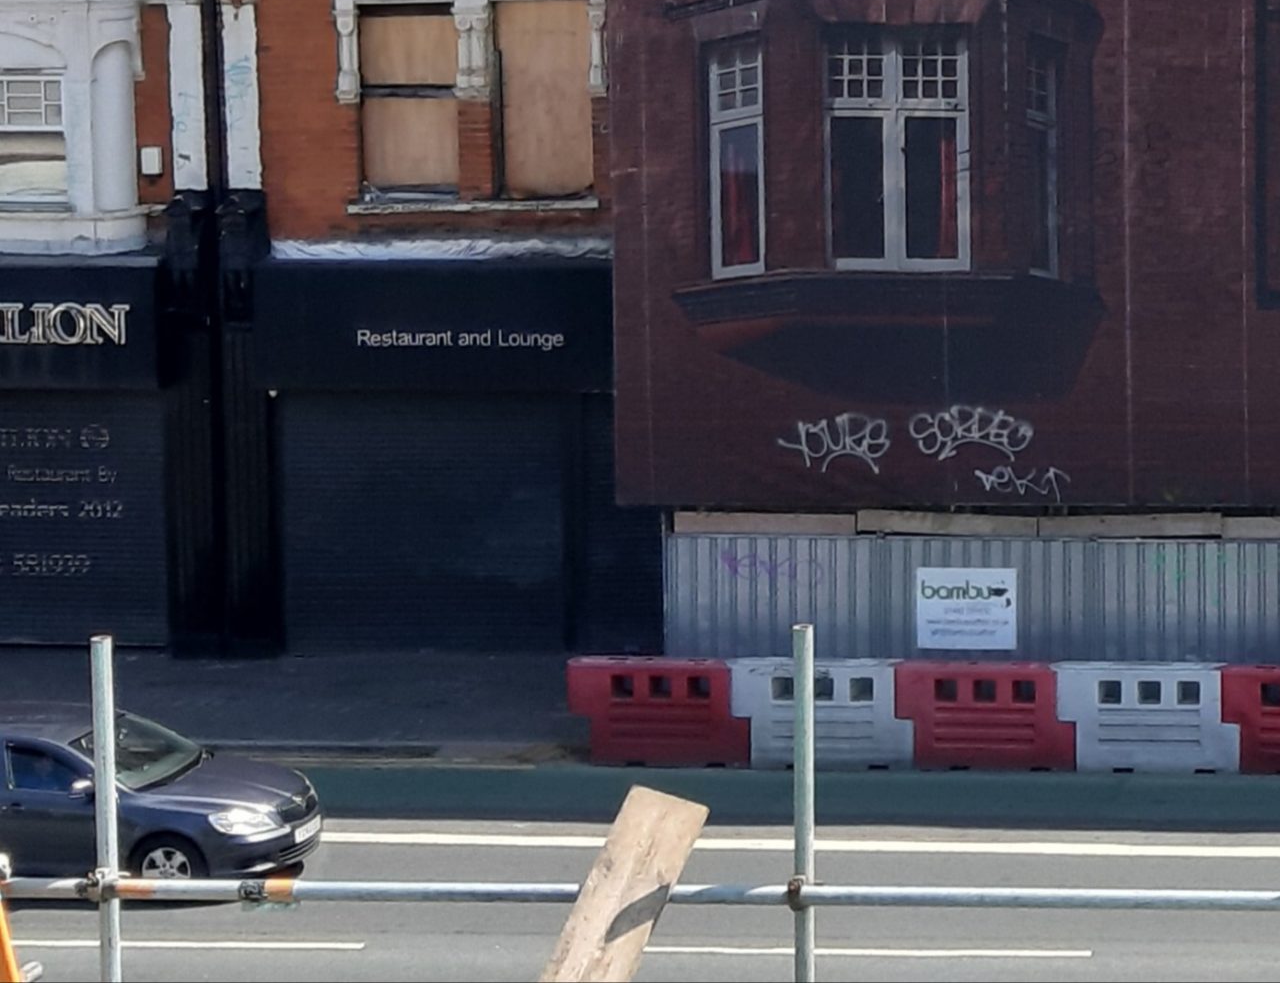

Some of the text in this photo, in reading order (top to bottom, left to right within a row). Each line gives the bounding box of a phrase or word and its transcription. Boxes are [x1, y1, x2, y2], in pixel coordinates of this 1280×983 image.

[356, 329, 564, 351] Restaurant and Lounge
[98, 465, 117, 484] By
[79, 500, 123, 518] 2012
[921, 579, 992, 600] bambu
